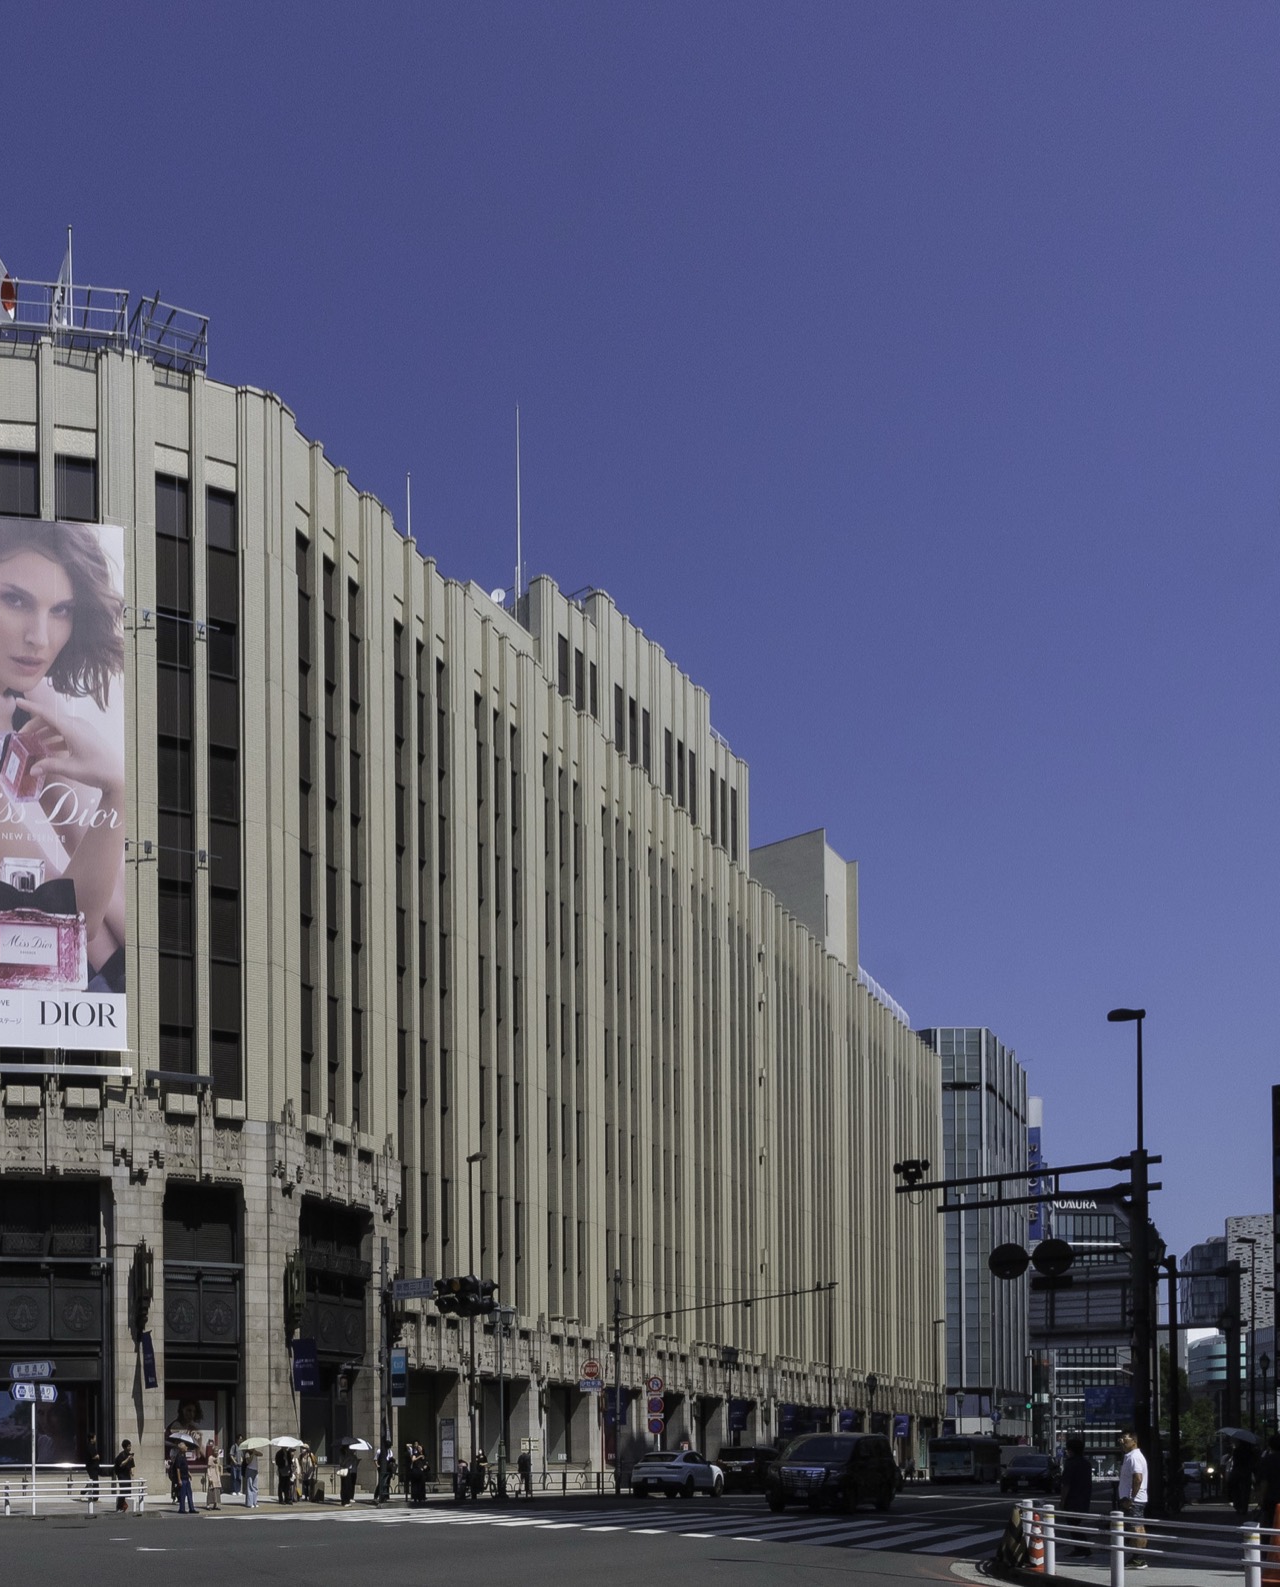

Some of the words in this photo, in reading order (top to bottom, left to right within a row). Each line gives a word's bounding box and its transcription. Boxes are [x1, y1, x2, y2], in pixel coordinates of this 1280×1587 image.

[35, 781, 123, 830] Dior
[1, 832, 24, 841] NEW
[2, 934, 30, 948] Miss
[31, 935, 54, 949] Dior
[38, 1000, 119, 1029] DIOR
[1052, 1199, 1098, 1210] NOMURA
